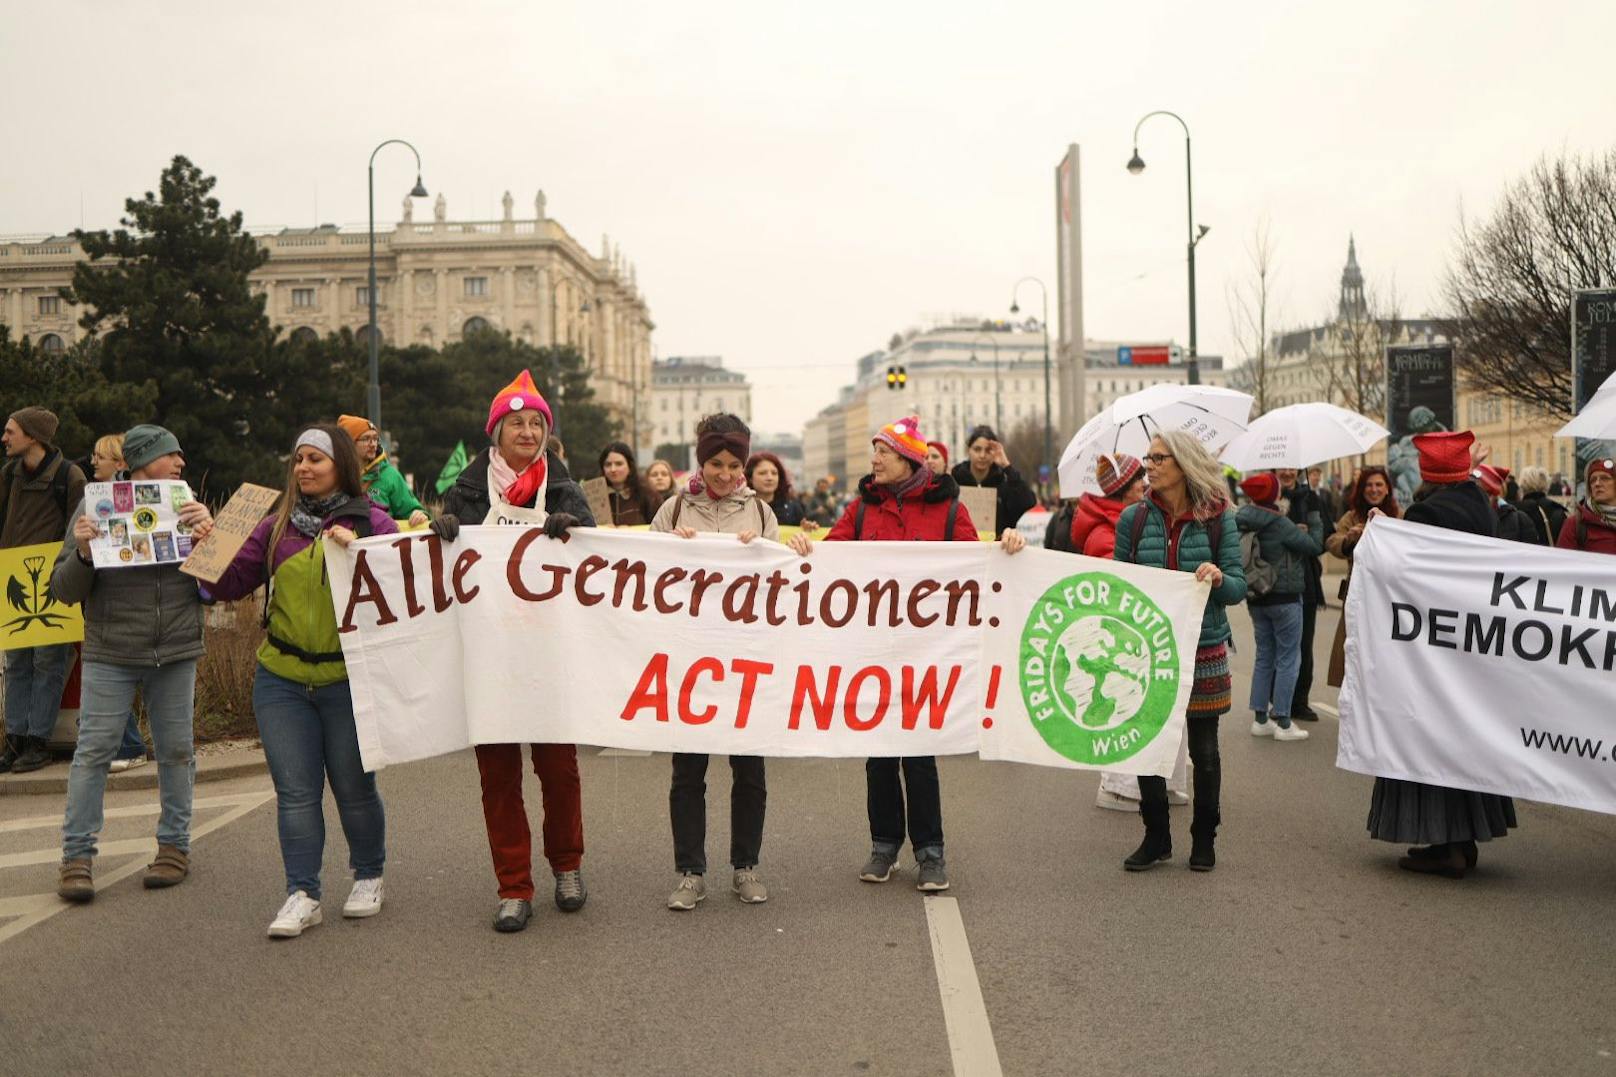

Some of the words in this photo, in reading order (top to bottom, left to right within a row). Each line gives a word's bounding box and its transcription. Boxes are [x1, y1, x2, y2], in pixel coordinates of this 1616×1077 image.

[1259, 451, 1286, 460] RECHTS
[1263, 443, 1287, 451] GEGEN
[338, 534, 482, 633] Alle
[507, 527, 1002, 628] Generationen:
[1025, 602, 1064, 721] FRIDAYS
[1064, 581, 1110, 609] FOR
[1119, 591, 1174, 681] FUTURE
[620, 653, 773, 728] ACT
[788, 665, 962, 731] NOW
[1092, 728, 1141, 756] Wien
[1521, 728, 1616, 762] www.
